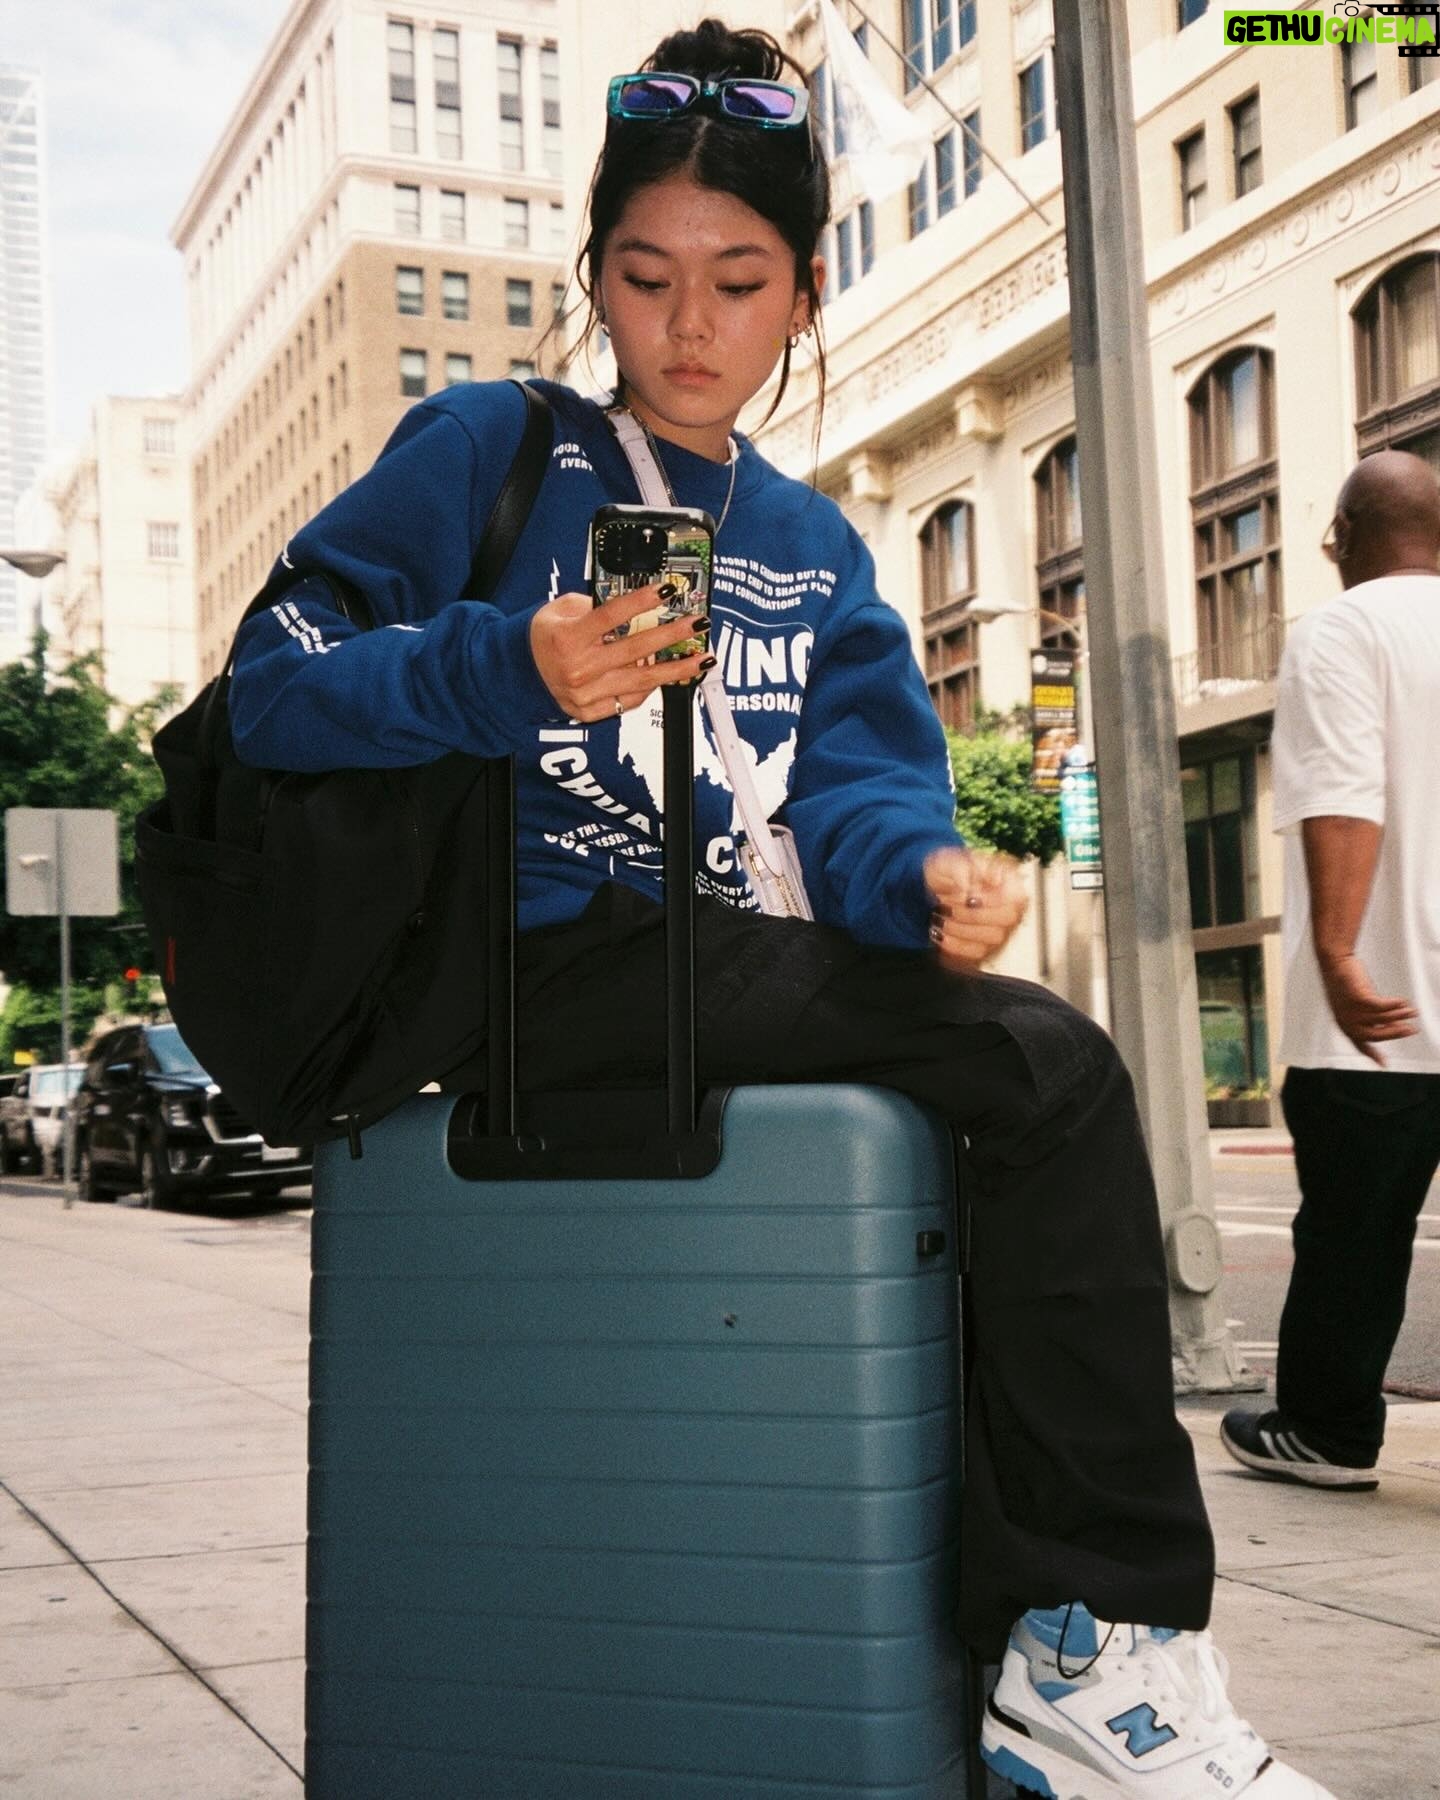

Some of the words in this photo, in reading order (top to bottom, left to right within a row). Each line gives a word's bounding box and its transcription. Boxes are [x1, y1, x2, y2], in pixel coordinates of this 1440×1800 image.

[720, 556, 748, 568] BORN
[749, 560, 759, 572] IN
[796, 570, 816, 581] BUT
[714, 579, 734, 593] AND
[735, 585, 801, 610] CONVERSATIONS
[763, 583, 774, 596] TO
[774, 583, 808, 597] SHARE
[577, 823, 600, 838] THE
[1204, 1760, 1235, 1790] 650
